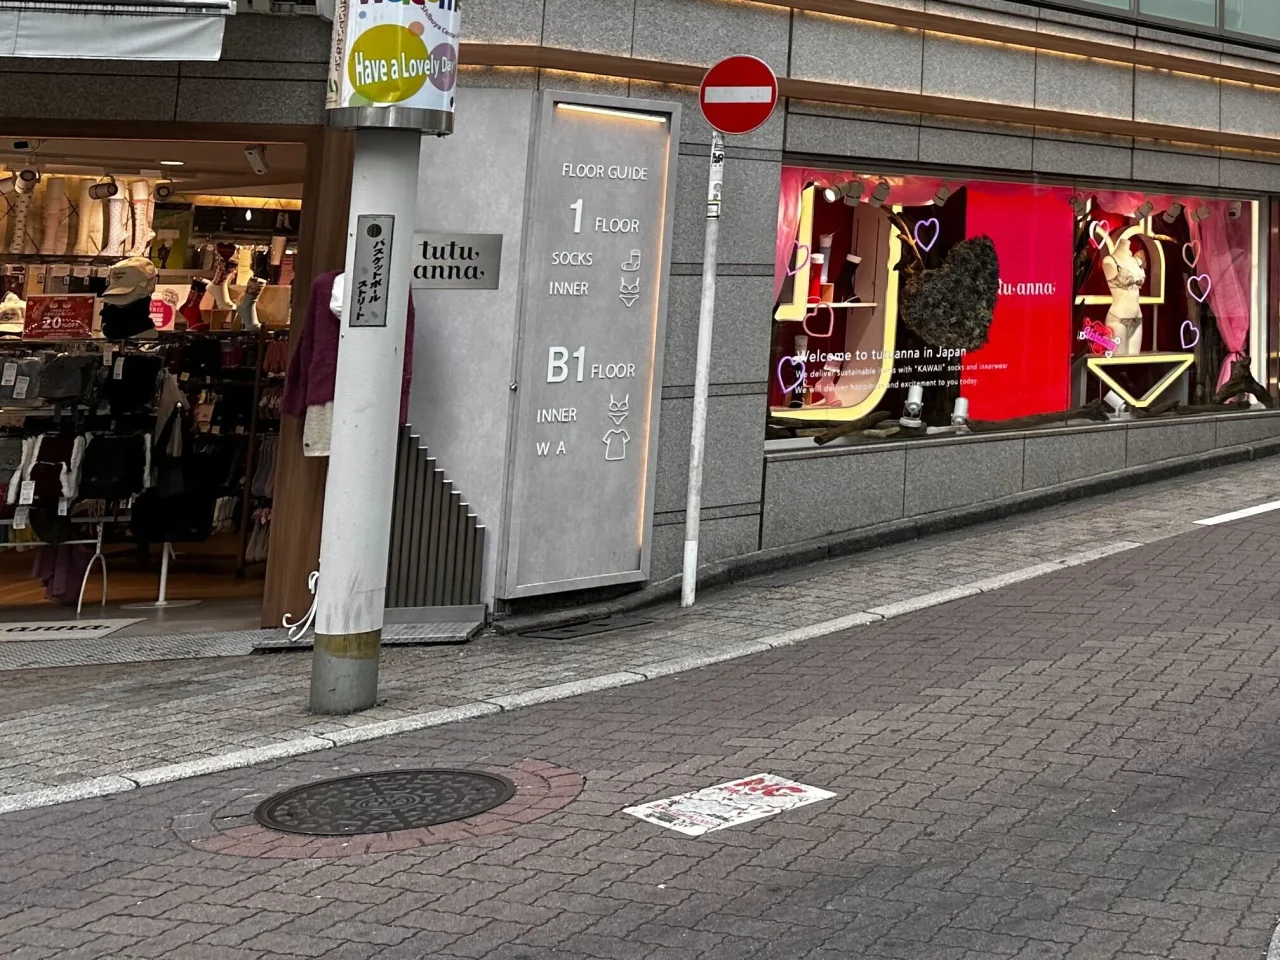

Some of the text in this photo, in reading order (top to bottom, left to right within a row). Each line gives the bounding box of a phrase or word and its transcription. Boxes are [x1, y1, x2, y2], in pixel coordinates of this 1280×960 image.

[420, 4, 441, 31] Shibuya
[355, 52, 388, 87] Have
[390, 59, 399, 79] a
[401, 52, 440, 79] Lovely
[562, 163, 648, 180] FLOOR GUIDE
[570, 198, 639, 233] 1 FLOOR
[418, 241, 479, 260] tutu
[551, 252, 593, 266] SOCKS
[369, 238, 386, 304] バスケットボール
[413, 264, 485, 280] anna
[549, 281, 589, 296] INNER
[356, 280, 368, 321] ストリート
[797, 349, 851, 362] Welcome
[855, 350, 867, 360] to
[923, 347, 932, 358] in
[936, 346, 966, 361] Japan
[546, 346, 635, 383] B1 FLOOR
[810, 370, 834, 378] deliver
[837, 367, 876, 376] sustainable
[898, 365, 912, 373] with
[901, 380, 936, 388] excitement
[946, 380, 958, 388] you
[536, 408, 577, 423] INNER
